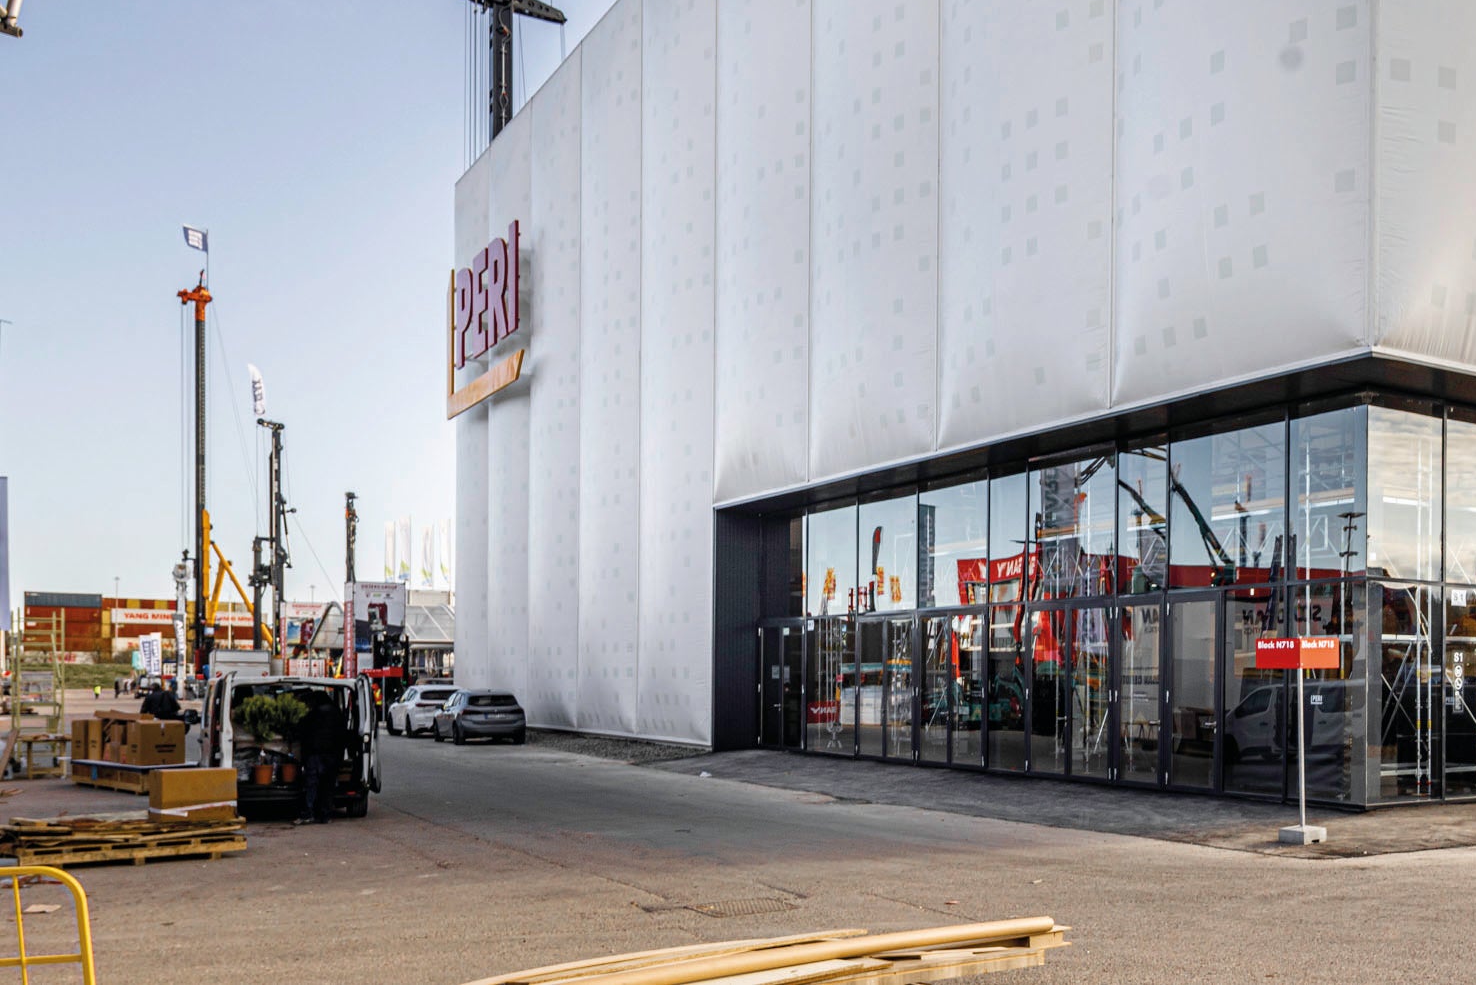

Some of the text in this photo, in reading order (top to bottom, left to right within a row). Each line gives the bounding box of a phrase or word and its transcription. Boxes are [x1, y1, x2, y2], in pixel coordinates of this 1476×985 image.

[456, 220, 519, 370] PERI
[124, 612, 149, 620] YANG
[1258, 641, 1275, 649] Block
[1301, 640, 1317, 648] Block
[1453, 652, 1463, 662] S1
